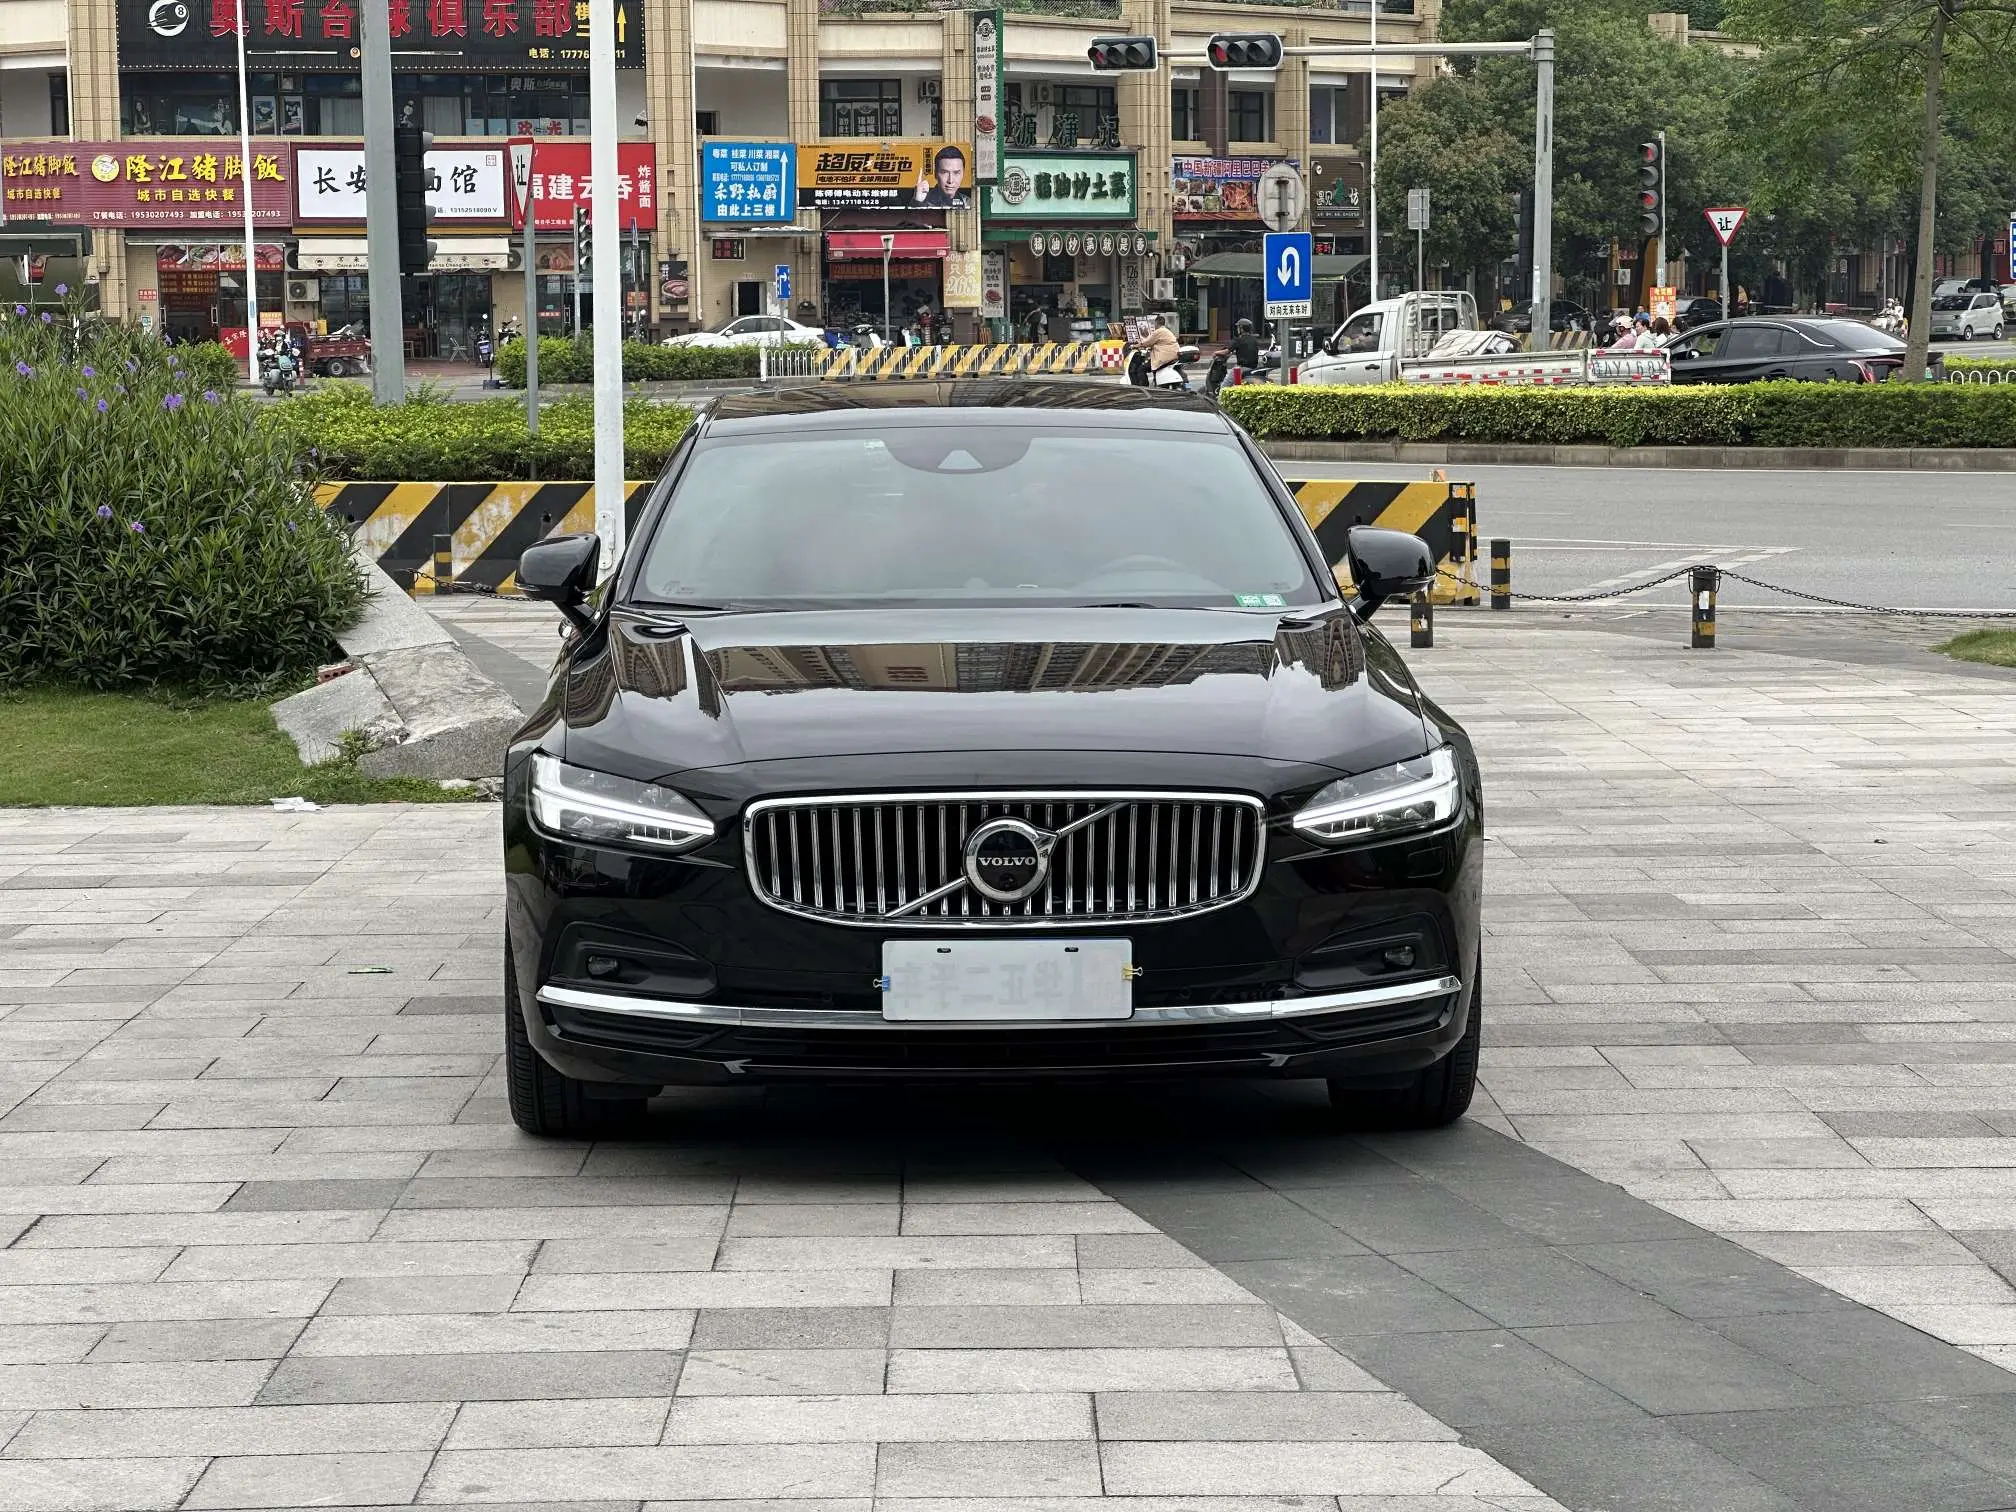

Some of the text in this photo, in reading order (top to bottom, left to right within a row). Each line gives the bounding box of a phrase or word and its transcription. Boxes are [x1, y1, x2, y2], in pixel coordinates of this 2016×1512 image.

[560, 49, 625, 58] 1777611
[515, 153, 527, 187] 让
[815, 153, 874, 172] 超威
[873, 159, 912, 172] 电池
[1183, 160, 1280, 177] 中国新疆阿里巴巴羊
[312, 164, 479, 195] 长安馆
[637, 165, 652, 209] 炸酱面
[137, 188, 235, 203] 城市自选快餐
[227, 210, 281, 219] 1953207493
[717, 203, 776, 217] 由此上三楼
[1717, 216, 1733, 231] 让
[1269, 304, 1308, 316] 对向无来车时
[978, 856, 1036, 867] VOLVO
